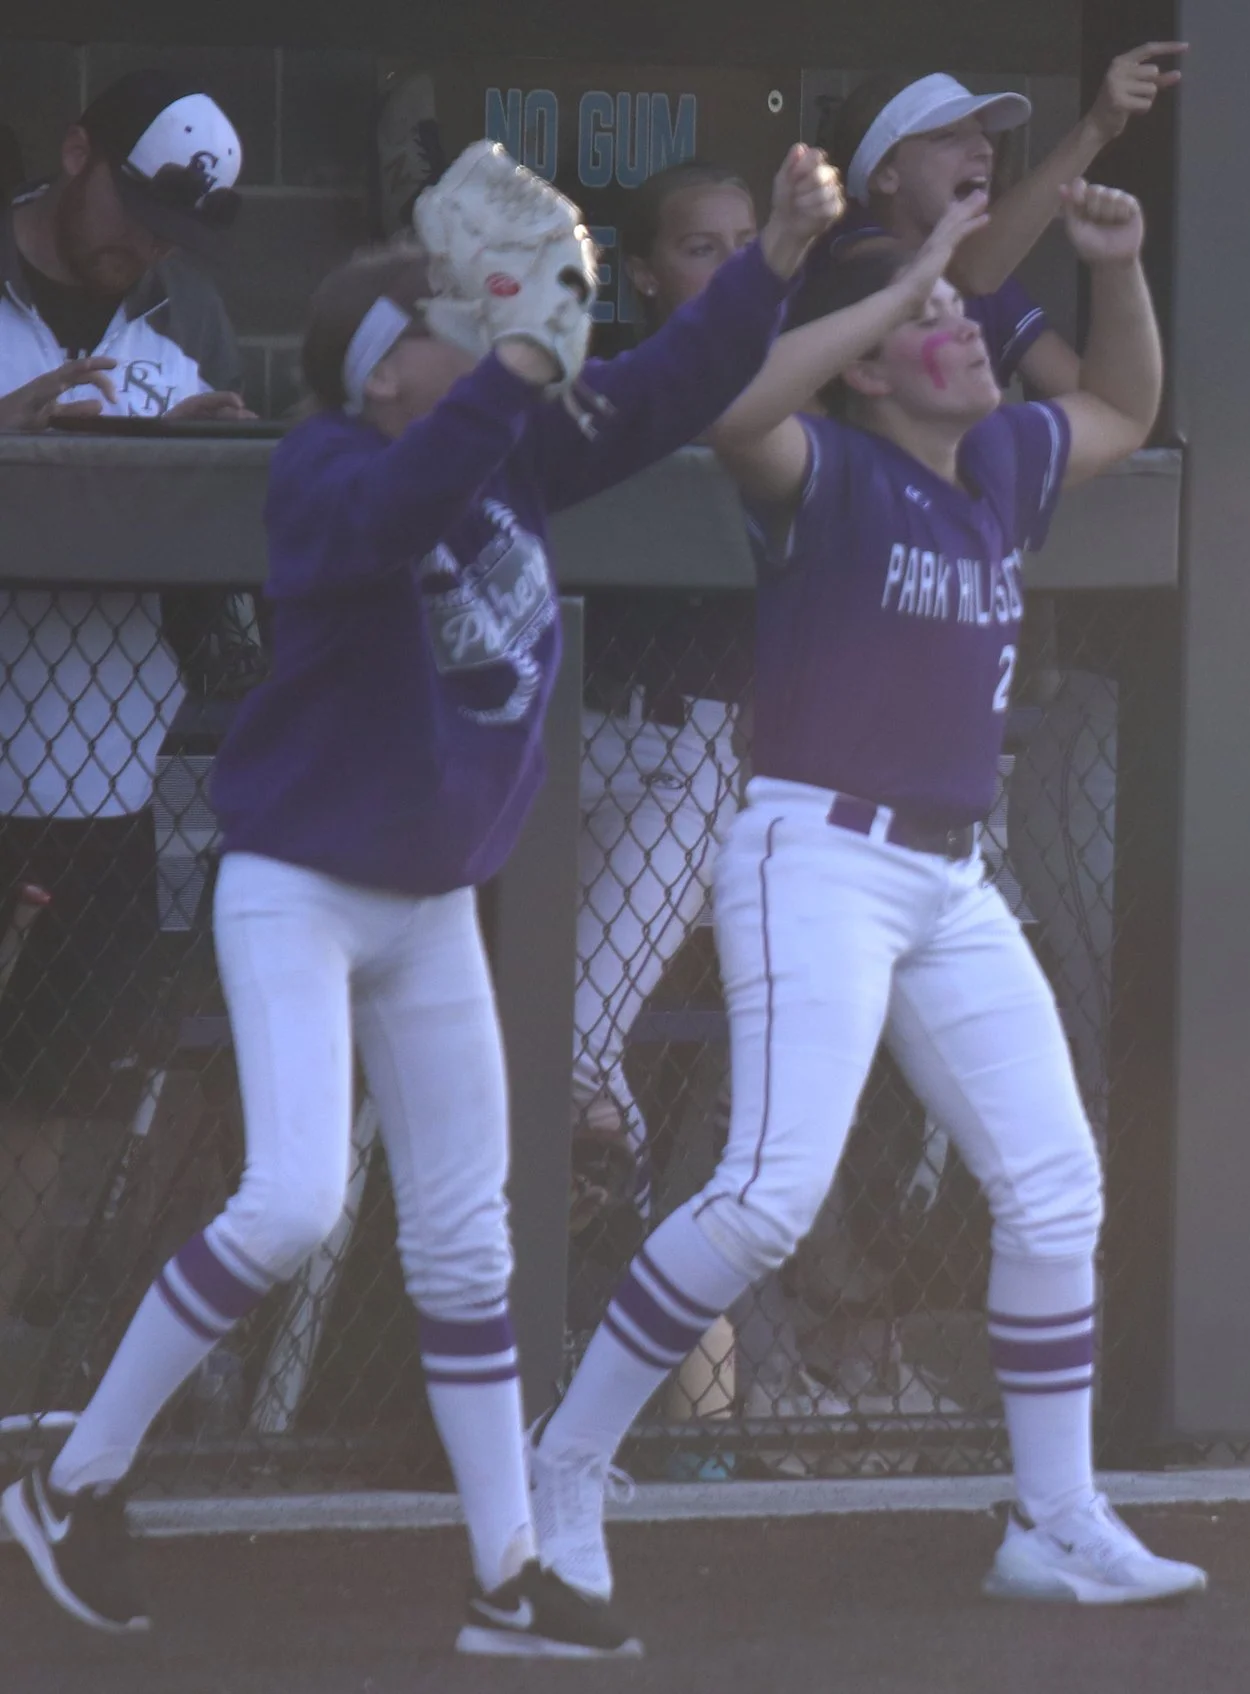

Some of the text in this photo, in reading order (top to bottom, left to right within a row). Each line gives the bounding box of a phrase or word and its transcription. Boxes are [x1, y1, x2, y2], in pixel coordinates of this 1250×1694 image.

[485, 87, 696, 188] NO GUM
[881, 543, 950, 621] PARK
[992, 644, 1017, 713] 2
